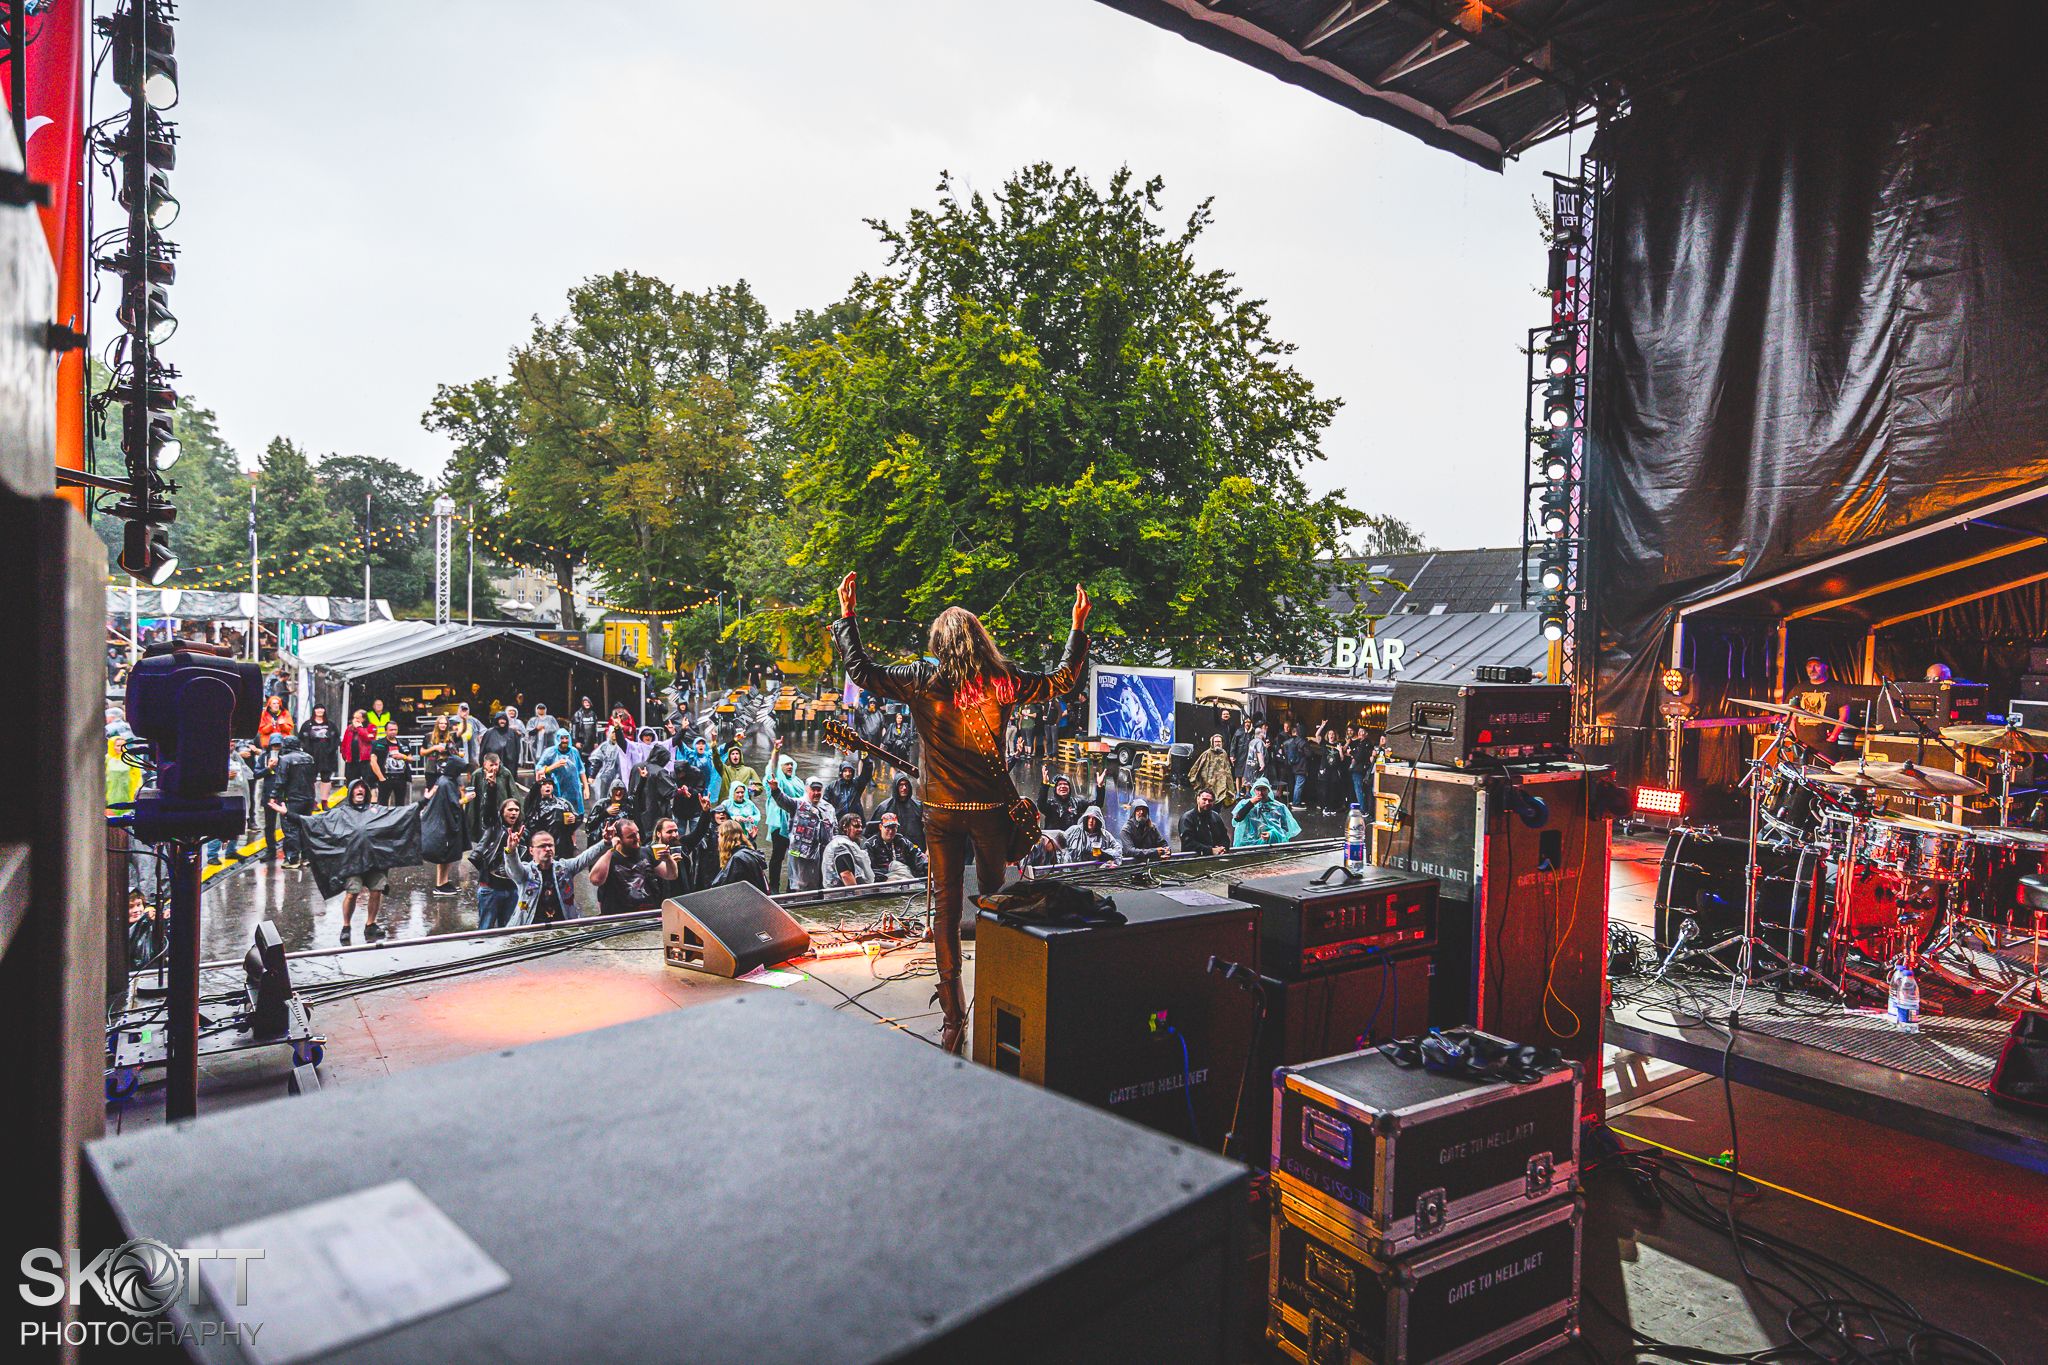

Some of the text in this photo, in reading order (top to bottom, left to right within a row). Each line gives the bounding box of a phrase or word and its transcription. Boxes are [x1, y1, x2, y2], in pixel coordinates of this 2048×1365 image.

[1336, 637, 1406, 671] BAR
[1892, 795, 1903, 804] TO
[1421, 862, 1470, 883] HELL.NET
[1109, 1068, 1209, 1104] GATE TO HELLNET
[1439, 1121, 1535, 1165] GATE TO HELL.NET
[1448, 1252, 1543, 1304] GATE TO HELL.NET
